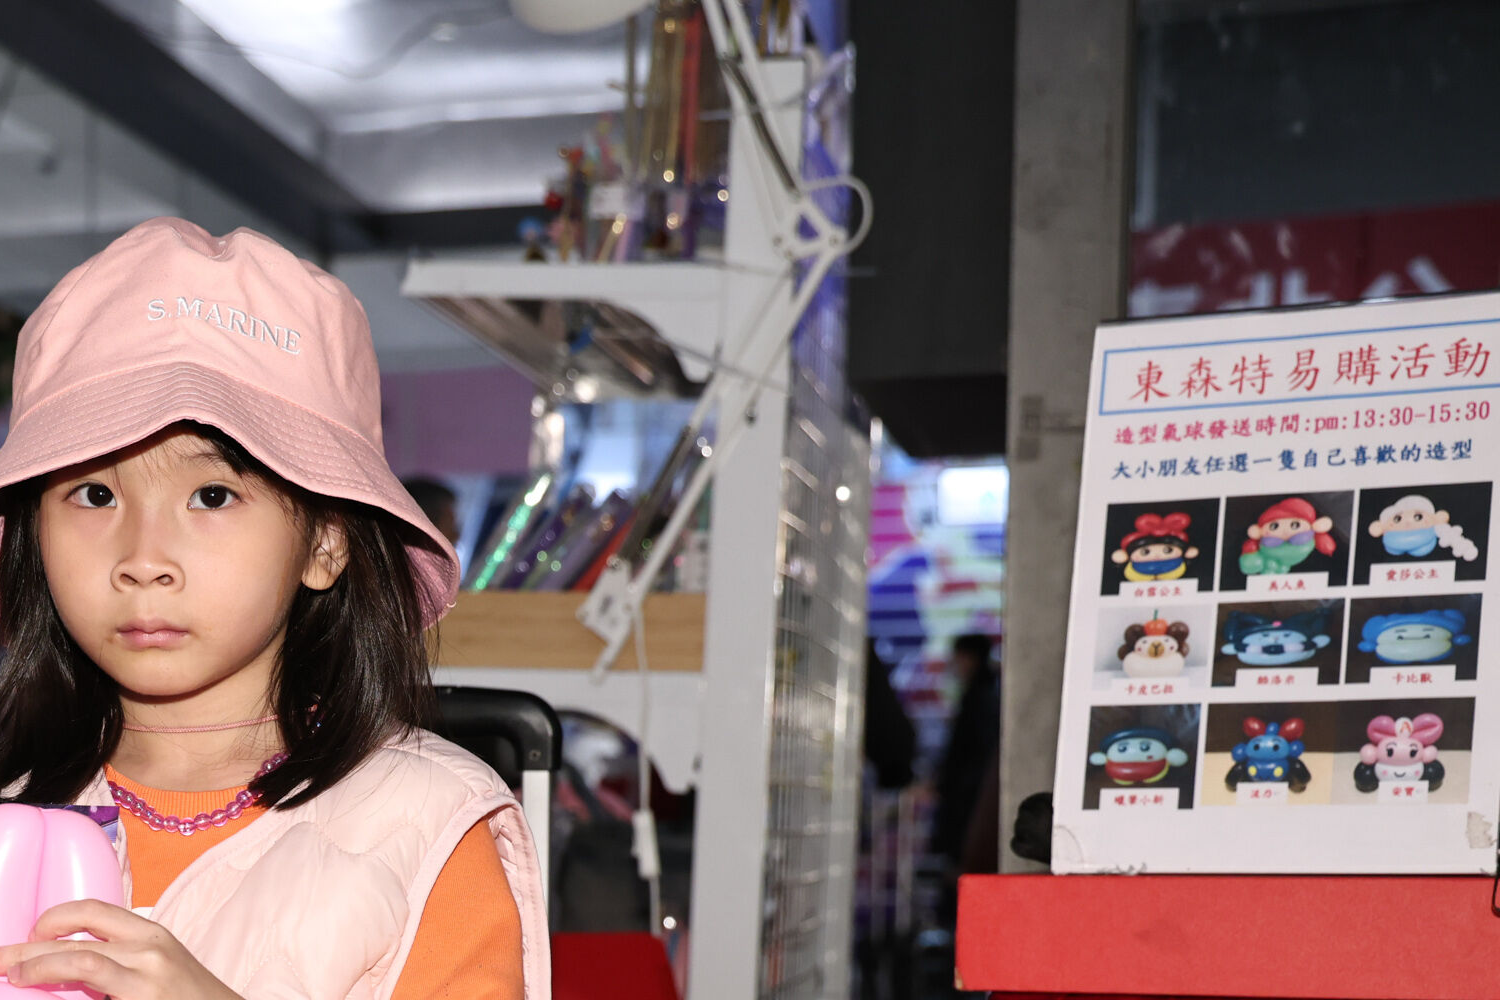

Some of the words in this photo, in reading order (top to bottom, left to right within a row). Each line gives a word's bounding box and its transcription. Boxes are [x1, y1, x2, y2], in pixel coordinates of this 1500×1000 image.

[1129, 337, 1491, 403] 東森特易購活動
[1111, 438, 1473, 480] 大小朋友任選一隻自己喜歡的造型
